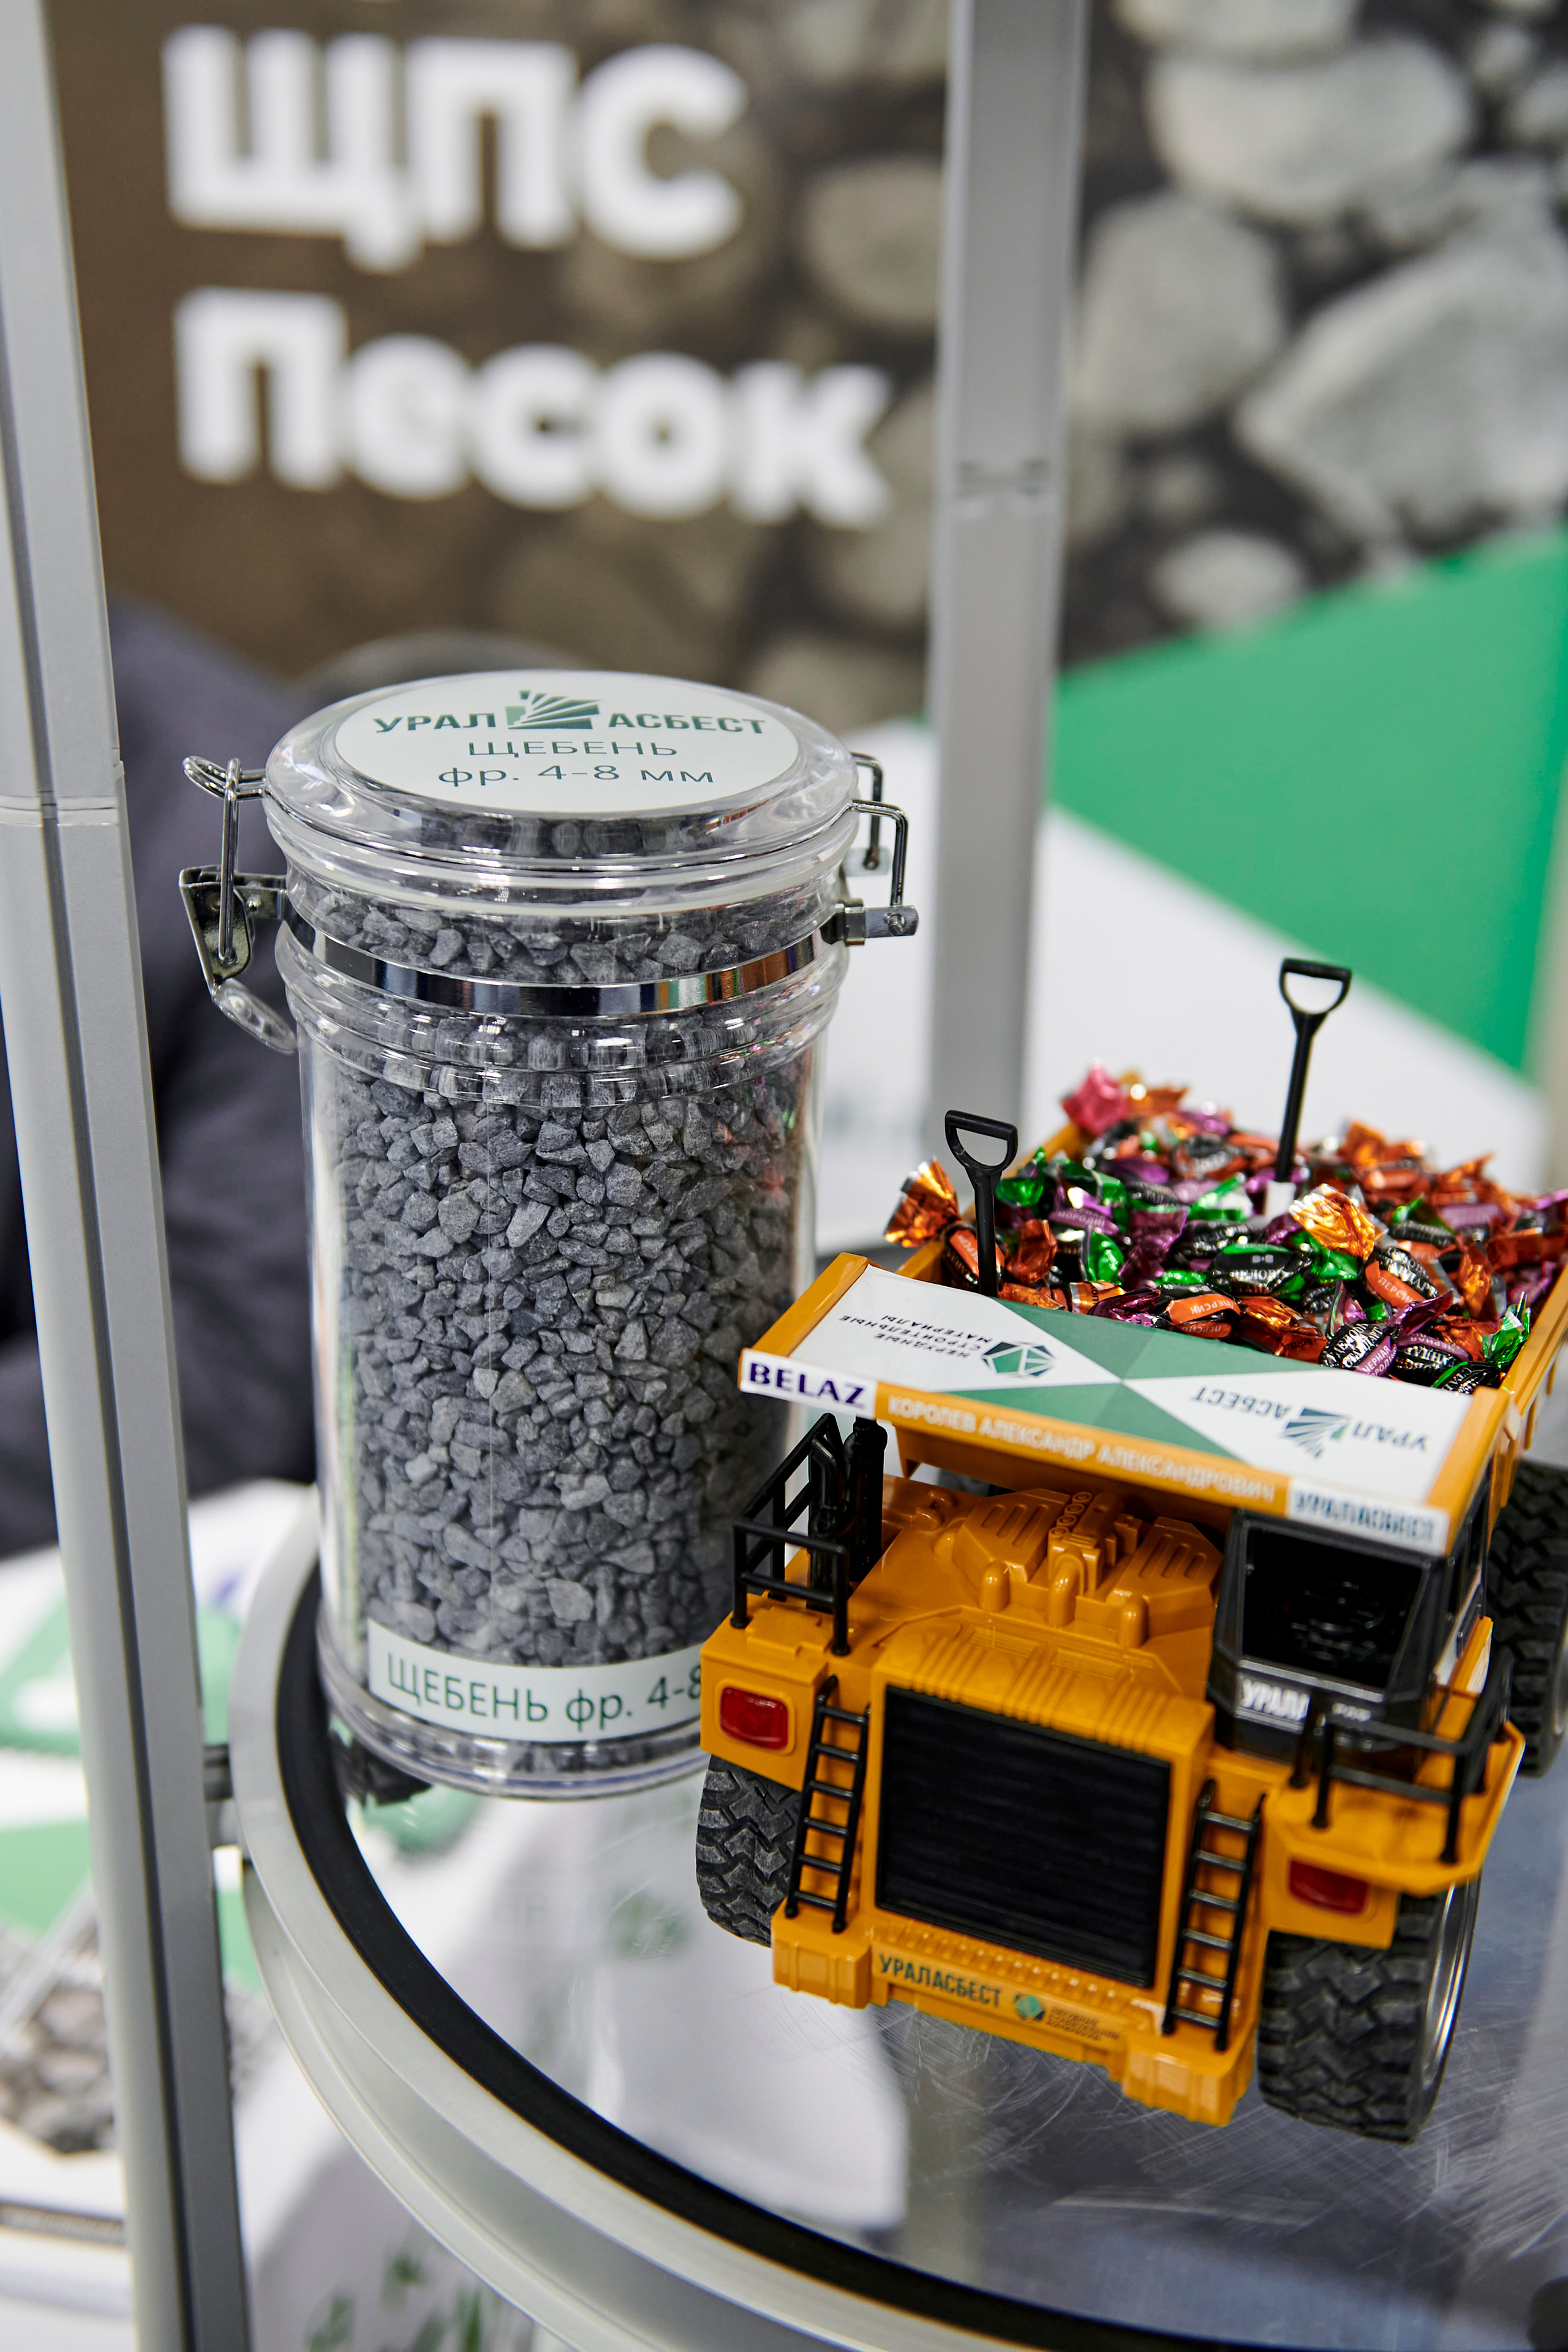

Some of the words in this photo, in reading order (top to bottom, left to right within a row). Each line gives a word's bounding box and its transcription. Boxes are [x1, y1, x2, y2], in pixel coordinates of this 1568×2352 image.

[163, 23, 747, 274] ЩПС
[175, 286, 889, 529] Песок
[373, 712, 496, 733] УРАЛ
[608, 712, 767, 734] АСБЕСТ
[469, 741, 677, 758] ЩЕБЕНЬ
[438, 766, 519, 787] фр.
[538, 764, 620, 782] 4-8
[641, 769, 714, 783] мм
[1378, 1277, 1414, 1303] ПЕРСИ
[1190, 1300, 1234, 1314] ПЕРСИК
[839, 1315, 981, 1351] СТРОИТЕЛЬНЫЕ
[881, 1315, 992, 1343] МАТЕРИАЛЫ
[1411, 1336, 1455, 1352] ЧЕРНАЯ
[1363, 1345, 1391, 1373] ЧЕРНАЯ
[749, 1362, 869, 1409] BELAZ
[1191, 1385, 1291, 1420] АСБЕСТ
[888, 1395, 976, 1433] КОРОЛЕВ
[979, 1416, 1096, 1461] АЛЕКСАНДР
[1098, 1443, 1276, 1502] АЛЕКСАНДРОВИЧ
[1351, 1420, 1431, 1451] УРАЛ
[388, 1653, 548, 1722] ЩЕБЕНЬ
[566, 1689, 632, 1732] фр.
[880, 1953, 1003, 2008] УРАЛАСБЕСТ
